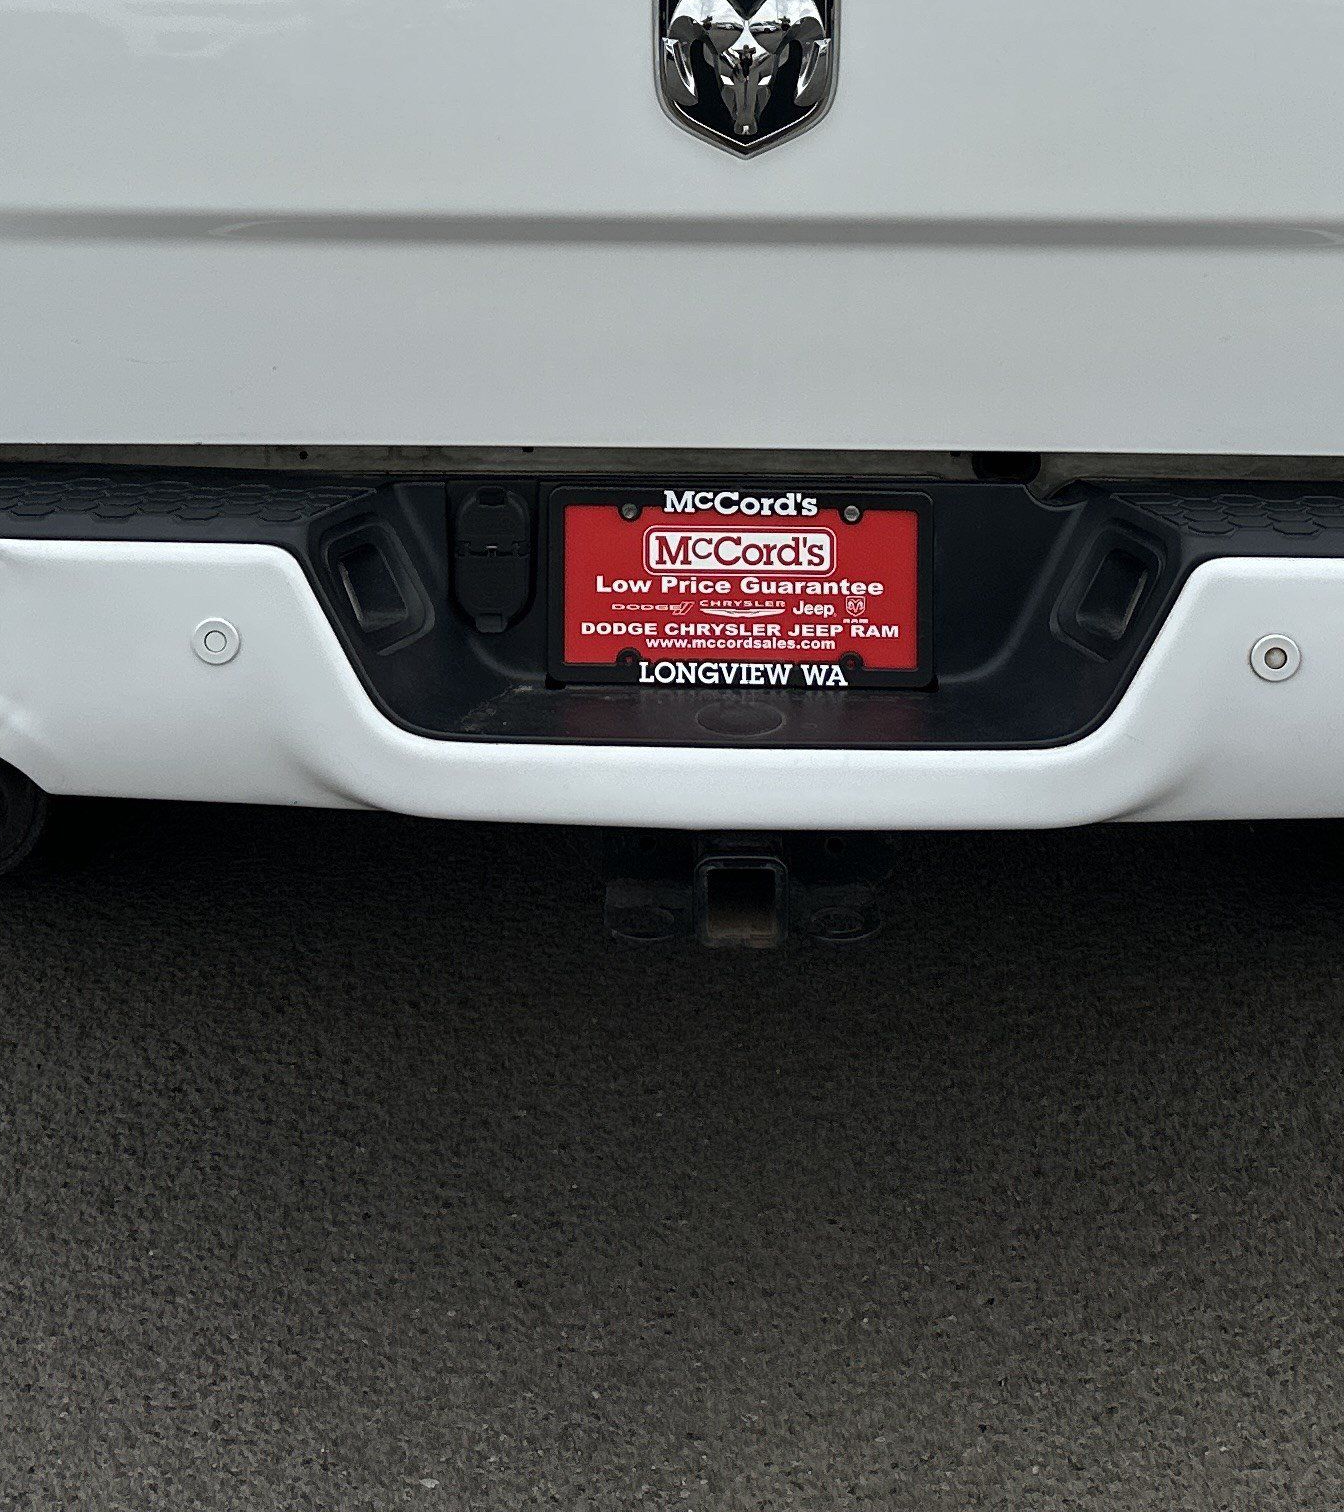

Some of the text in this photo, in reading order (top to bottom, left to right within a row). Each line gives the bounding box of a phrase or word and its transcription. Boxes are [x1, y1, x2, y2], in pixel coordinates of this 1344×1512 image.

[663, 490, 818, 516] McCord's
[655, 536, 825, 567] McCord's
[596, 575, 884, 595] Low Price Guarantee
[611, 603, 682, 611] DODGE
[699, 599, 786, 608] CHRYSLER
[792, 600, 835, 618] Jeep
[581, 622, 899, 638] DODGE CHRYSLER JEEP RAM
[645, 637, 836, 650] www.mccordsales.com
[639, 662, 849, 686] LONGVIEW WA
